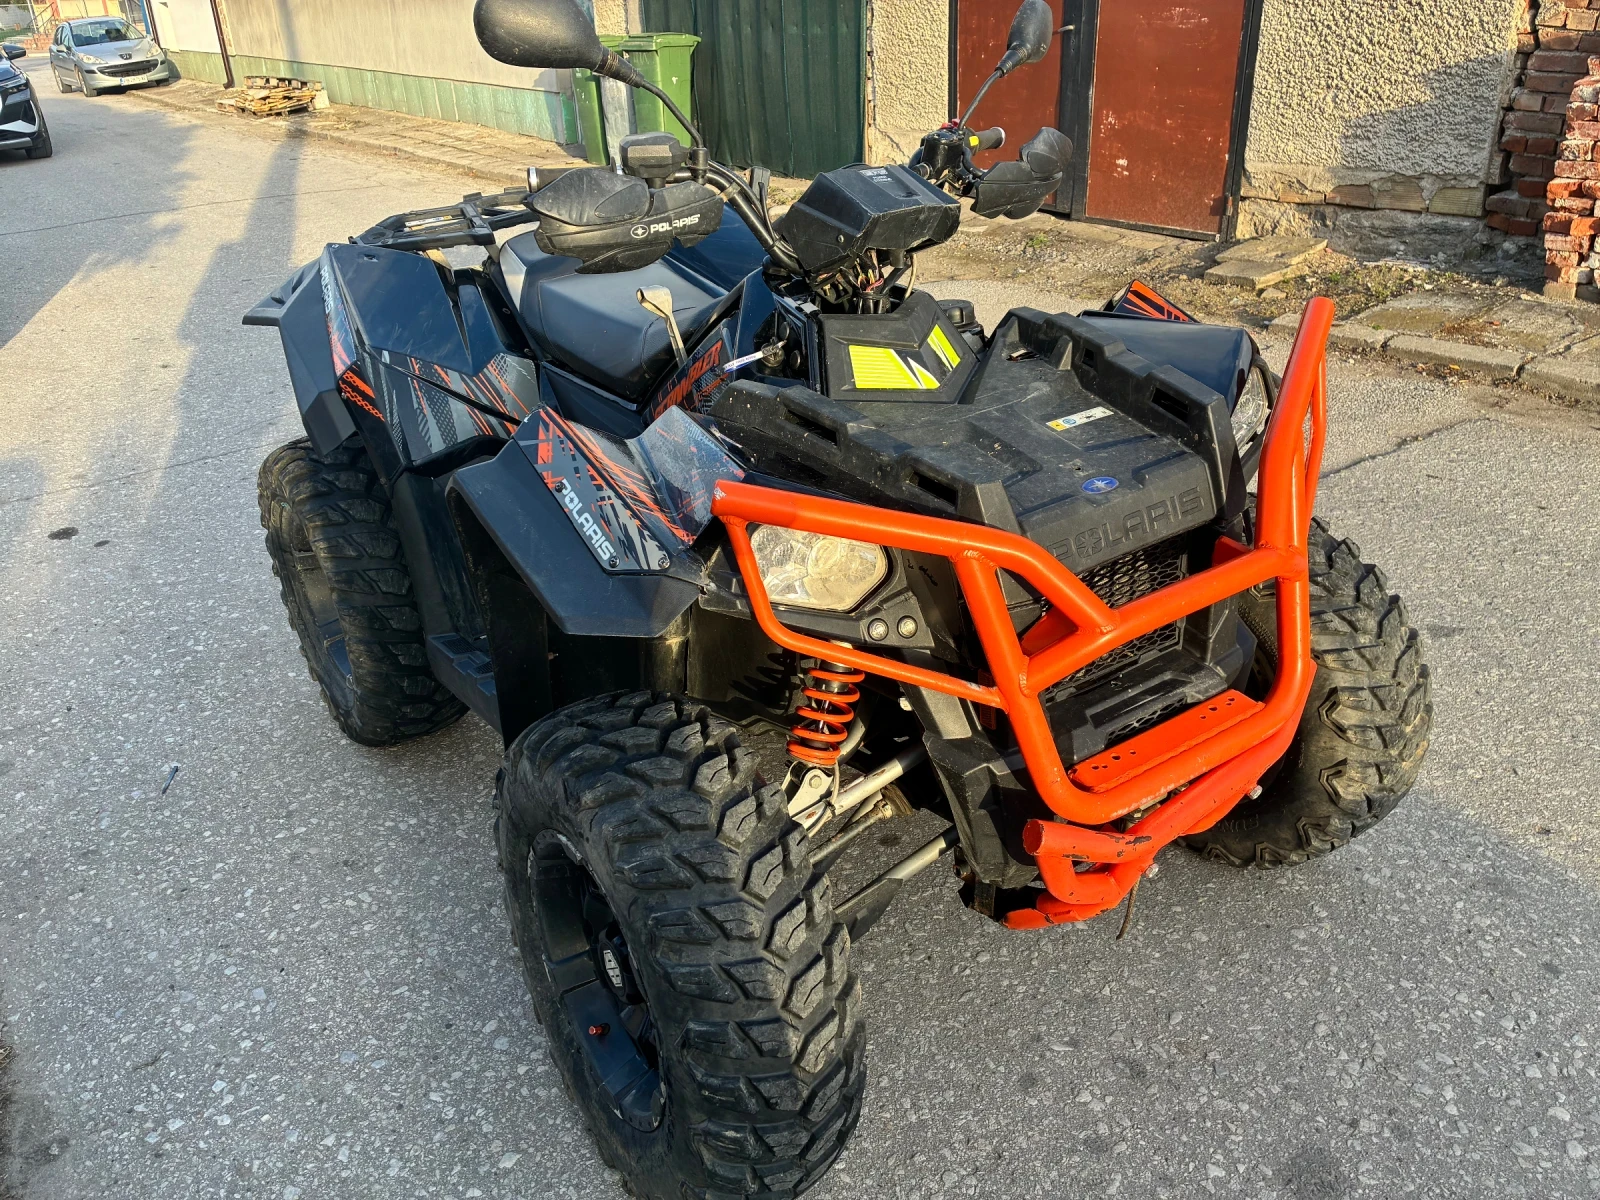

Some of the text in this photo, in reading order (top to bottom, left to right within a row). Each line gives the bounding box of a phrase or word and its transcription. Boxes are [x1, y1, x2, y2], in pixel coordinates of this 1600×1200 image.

[650, 214, 701, 234] POLARIS
[320, 265, 334, 314] POLARIS
[559, 478, 616, 561] POLARIS
[1046, 486, 1205, 561] POLARIS
